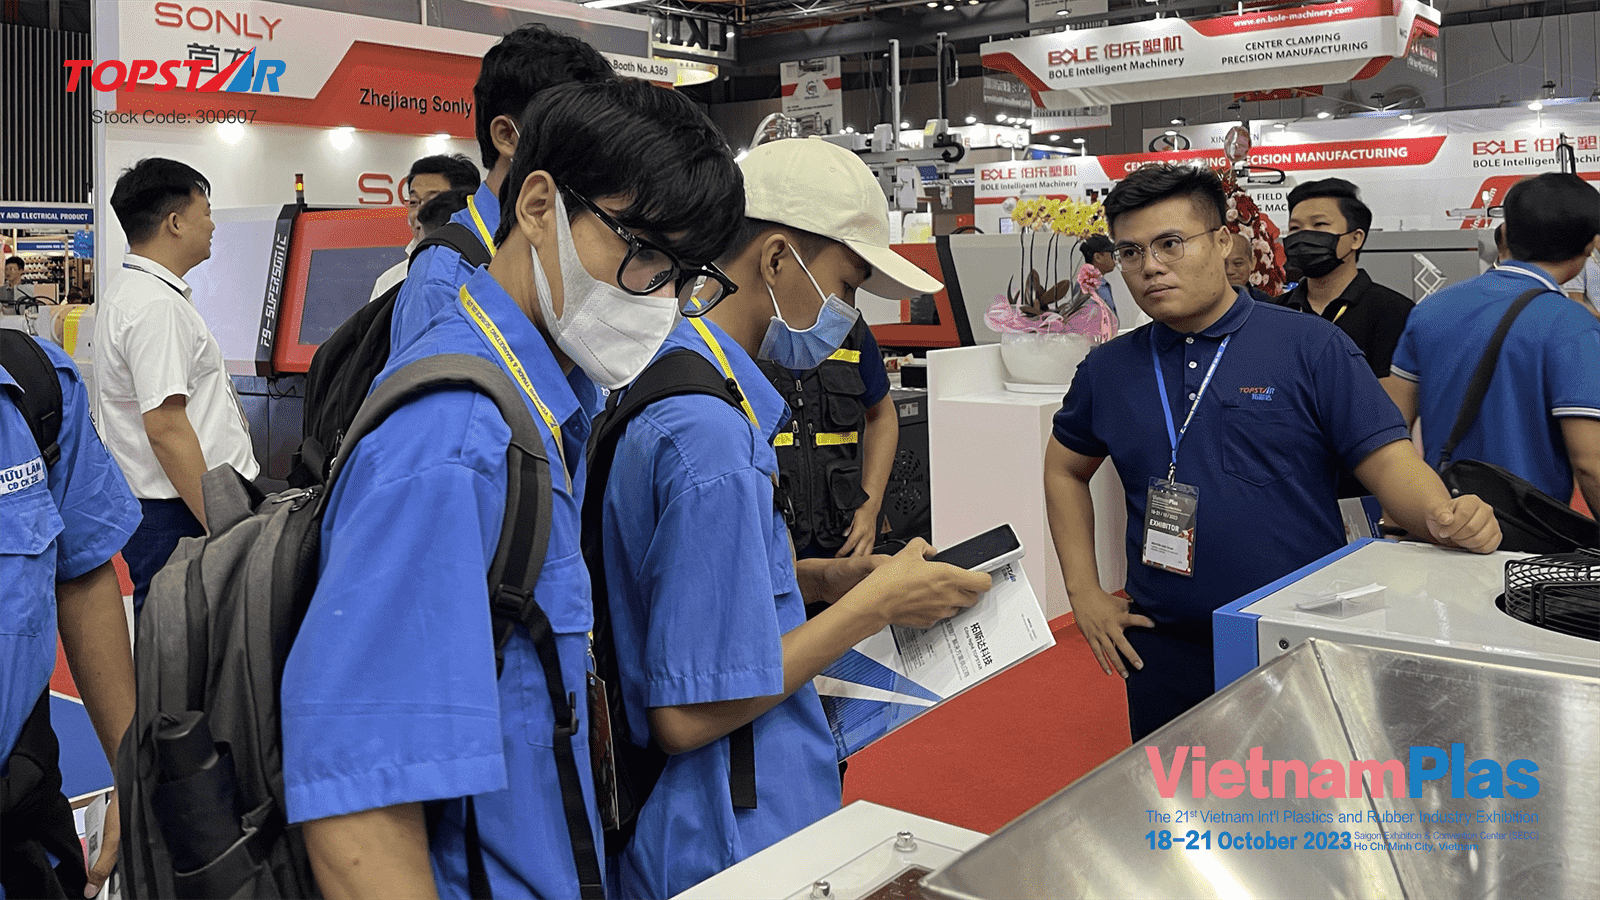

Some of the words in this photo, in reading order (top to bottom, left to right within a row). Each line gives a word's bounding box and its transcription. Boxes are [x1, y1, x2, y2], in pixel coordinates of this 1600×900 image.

[154, 1, 282, 41] SONLY
[1233, 6, 1353, 27] www.en.bole-machinery.com
[1103, 35, 1184, 60] 伯乐塑机
[1245, 39, 1283, 51] CENTER
[1285, 33, 1341, 47] CLAMPING
[1221, 52, 1273, 66] PRECISION
[1275, 41, 1369, 59] MANUFACTURING
[613, 59, 635, 72] Booth
[1048, 68, 1075, 79] BOLE
[1076, 62, 1128, 76] Intelligent
[1130, 56, 1185, 71] Machinery
[359, 88, 427, 114] Zhejiang
[431, 95, 473, 119] Sonly
[1294, 146, 1408, 163] MANUFACTURING
[1473, 159, 1501, 168] BOLE
[981, 183, 999, 191] BOLE
[1000, 181, 1038, 190] Intelligent
[1039, 180, 1078, 189] Machinery
[1257, 193, 1282, 201] FIELD
[21, 212, 58, 220] ELECTRICAL
[1149, 518, 1180, 533] EXHIBITOR
